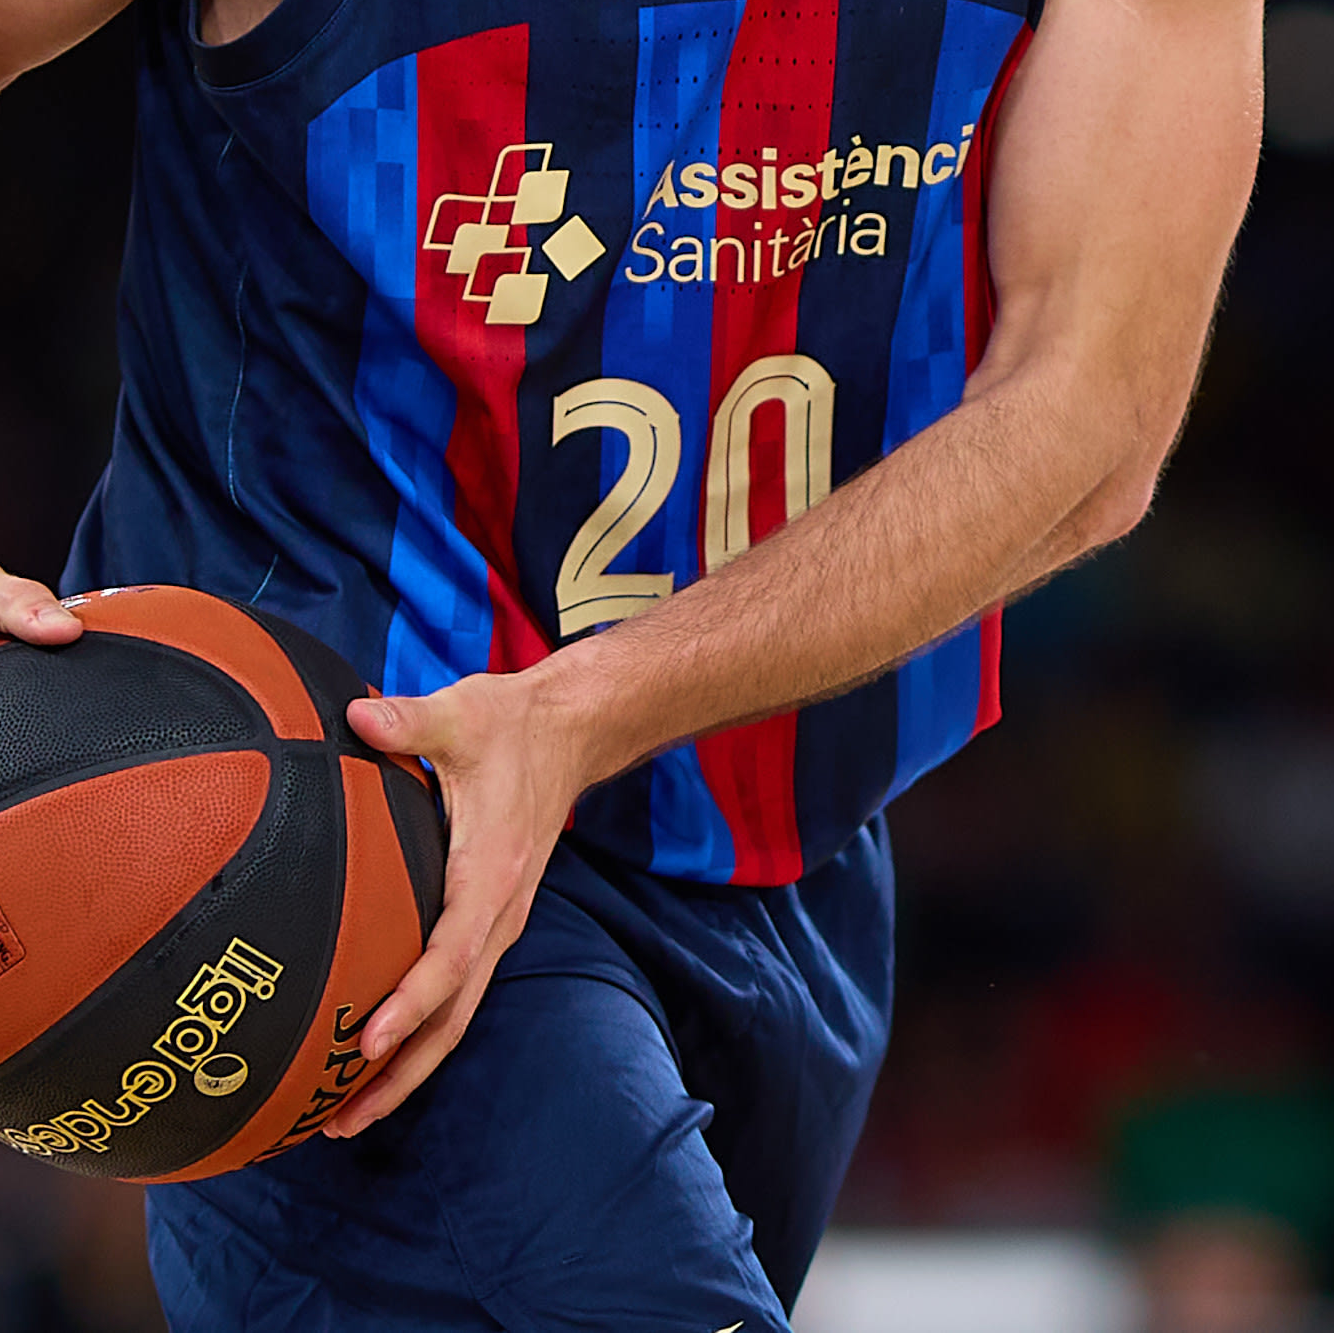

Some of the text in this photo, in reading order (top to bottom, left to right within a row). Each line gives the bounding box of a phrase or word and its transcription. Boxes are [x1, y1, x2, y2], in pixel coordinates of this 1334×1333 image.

[641, 122, 975, 221] Assistènci
[624, 197, 887, 284] Sanitària
[551, 354, 837, 638] 20
[151, 936, 284, 1072] liga
